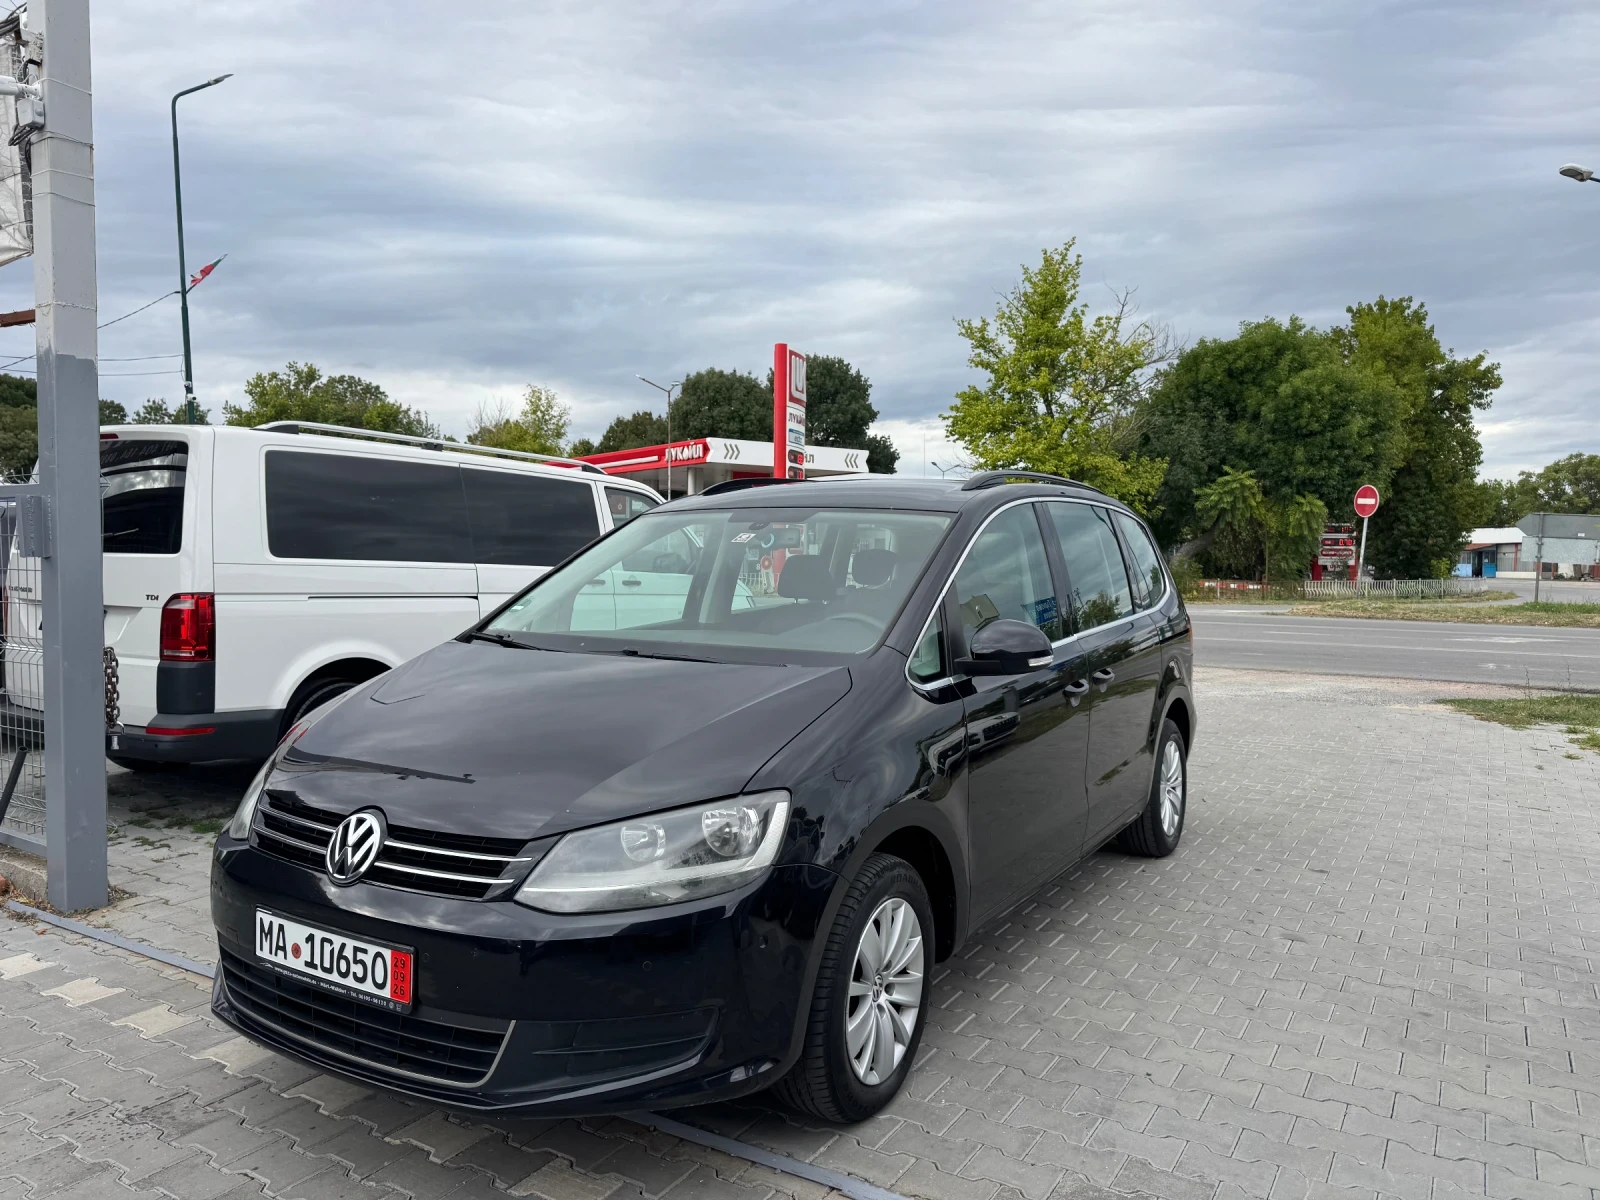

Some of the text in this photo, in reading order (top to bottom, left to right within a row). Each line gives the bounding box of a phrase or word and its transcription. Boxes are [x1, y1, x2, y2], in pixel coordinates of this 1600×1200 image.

[665, 442, 704, 463] ЛУКОЙЛ
[260, 917, 388, 990] MA 10650
[393, 957, 405, 969] 29
[394, 970, 405, 982] 09
[393, 984, 405, 995] 26
